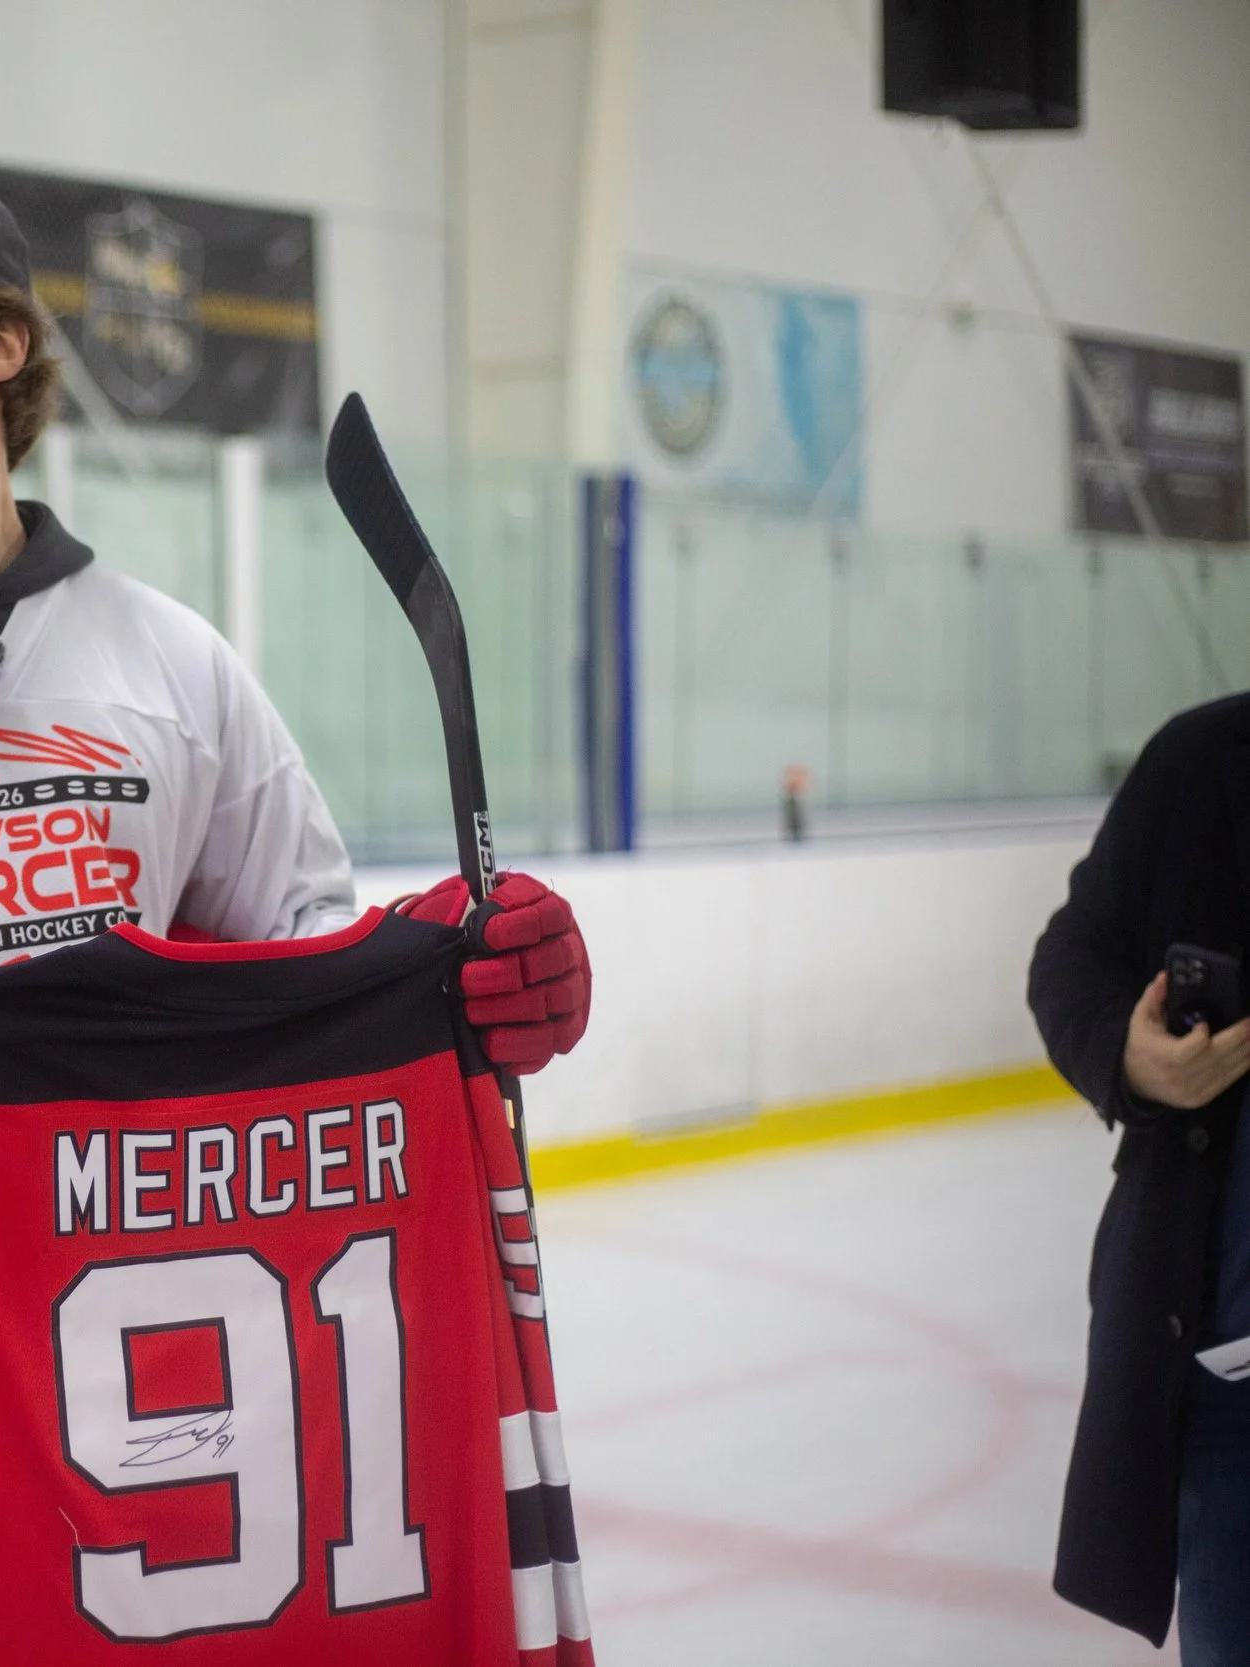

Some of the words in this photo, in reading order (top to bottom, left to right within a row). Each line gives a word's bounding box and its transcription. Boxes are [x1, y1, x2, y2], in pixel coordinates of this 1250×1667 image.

[10, 914, 97, 947] HOCKEY
[54, 1097, 410, 1237] MERCER
[52, 1228, 431, 1643] 91
